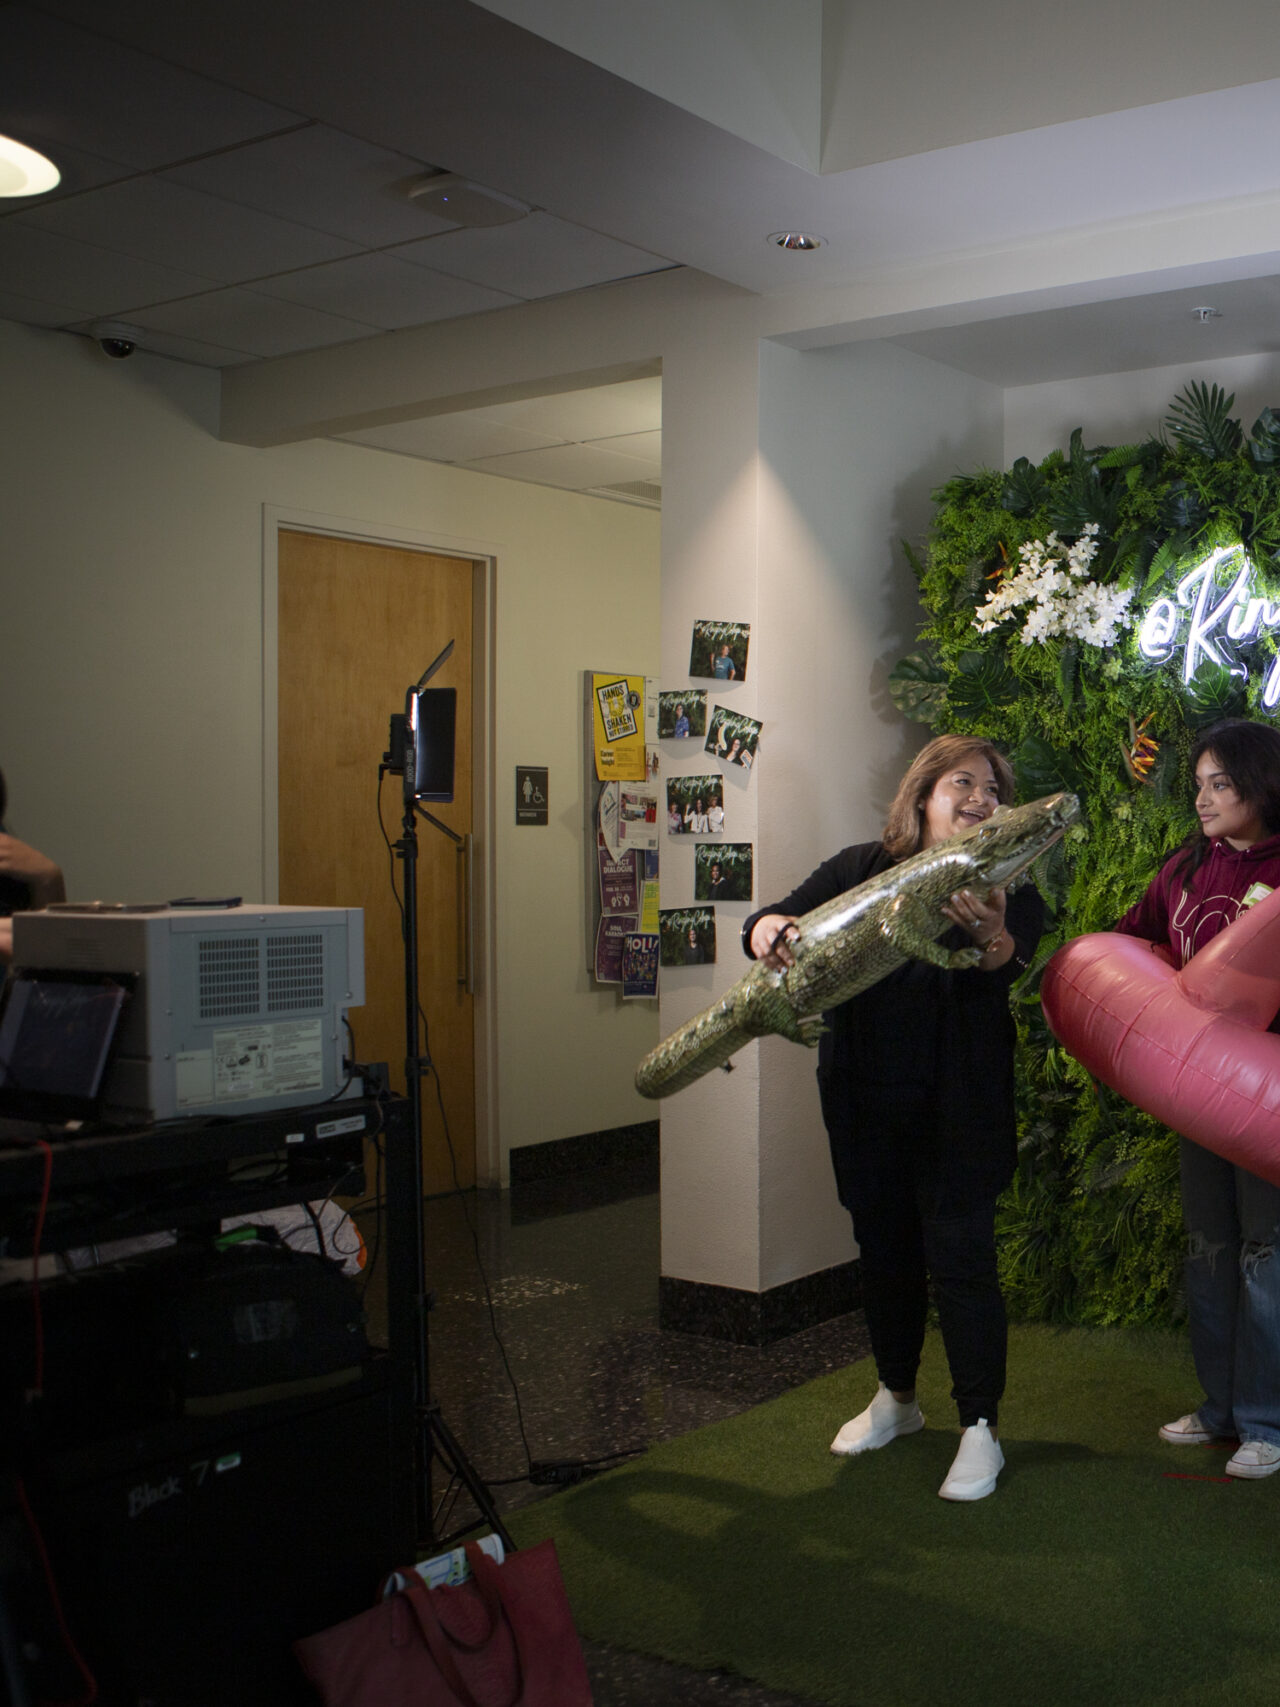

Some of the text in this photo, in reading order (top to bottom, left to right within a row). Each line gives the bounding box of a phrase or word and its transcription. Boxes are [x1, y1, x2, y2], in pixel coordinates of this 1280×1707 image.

[602, 685, 624, 701] HANDS
[607, 713, 632, 730] SHAKEN
[603, 865, 633, 874] DIALOGUE
[606, 858, 629, 866] IMACT
[627, 936, 659, 953] HOLI!
